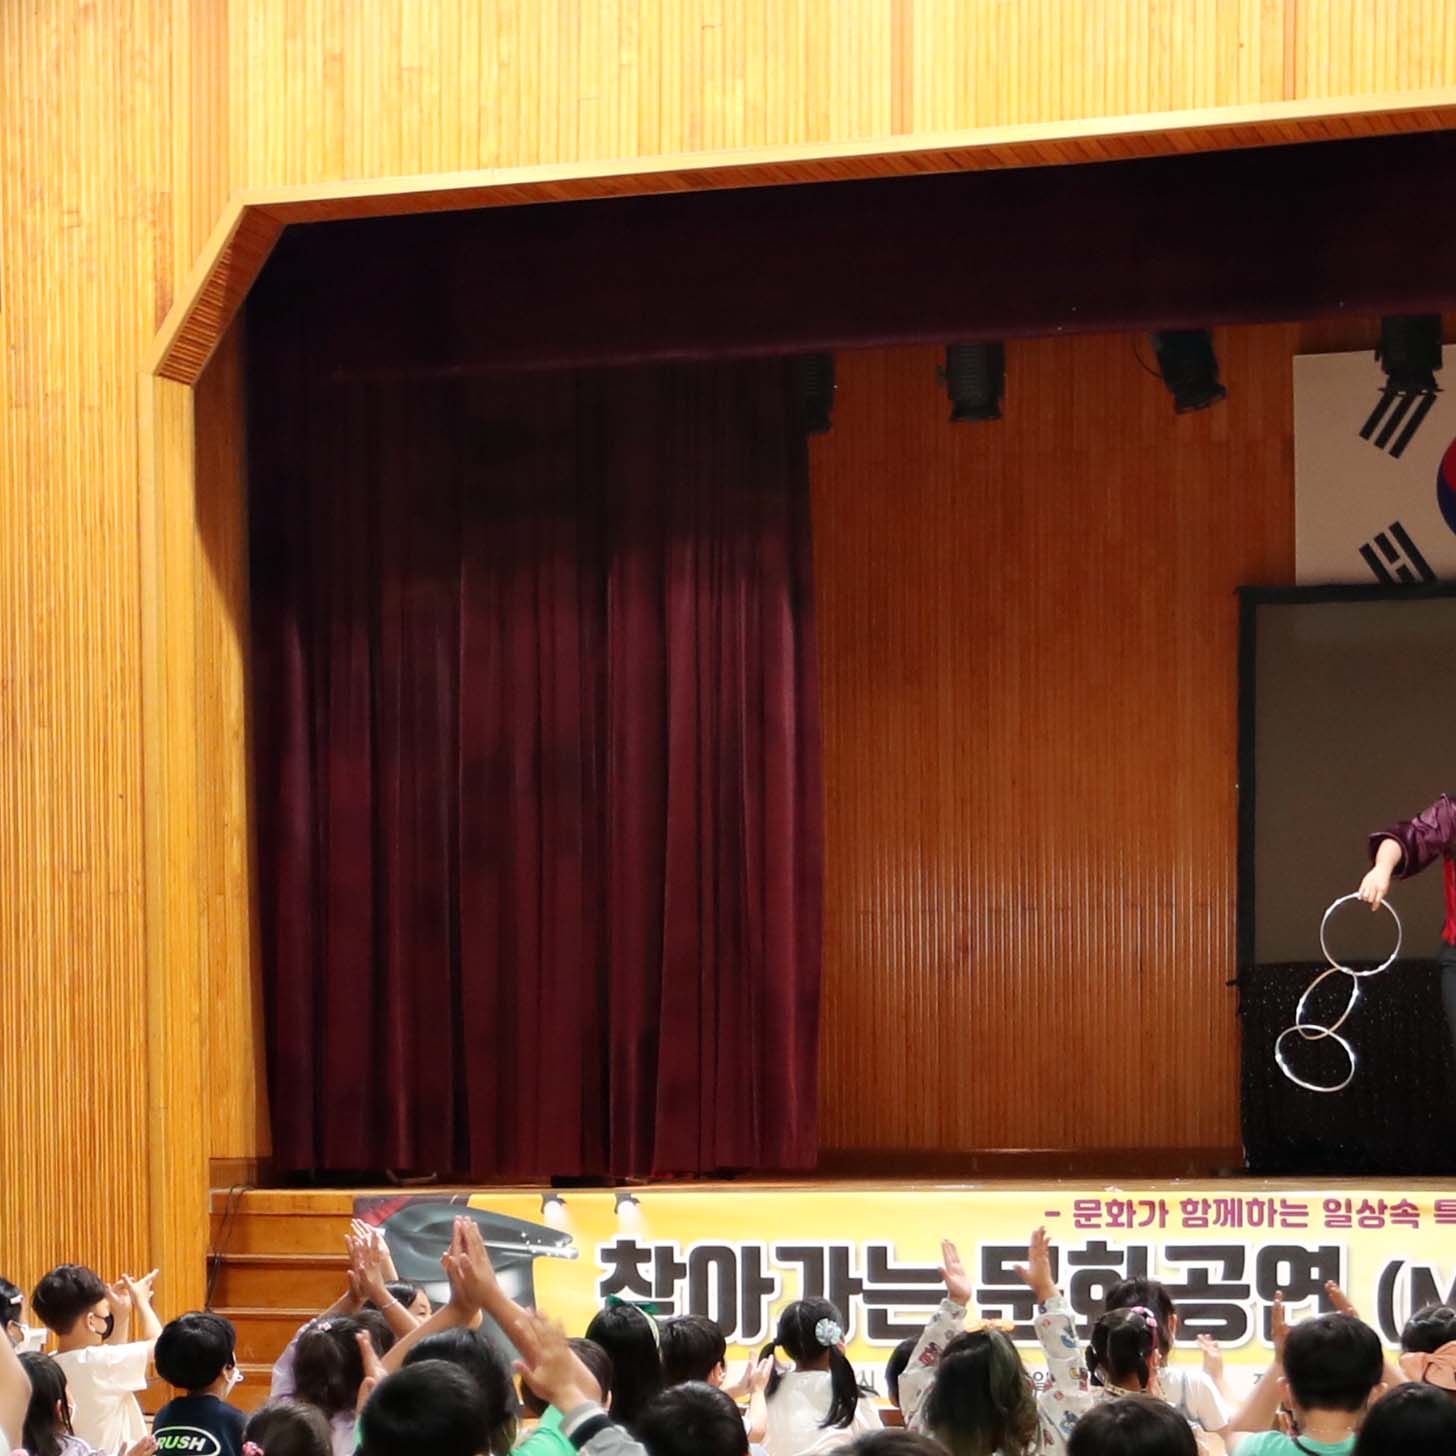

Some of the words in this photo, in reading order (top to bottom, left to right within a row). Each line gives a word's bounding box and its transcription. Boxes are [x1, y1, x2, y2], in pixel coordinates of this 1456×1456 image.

[1073, 1198, 1169, 1229] 문화가
[1179, 1198, 1309, 1229] 함께하는
[1322, 1198, 1421, 1229] 일상속
[977, 1240, 1341, 1342] 문화공연
